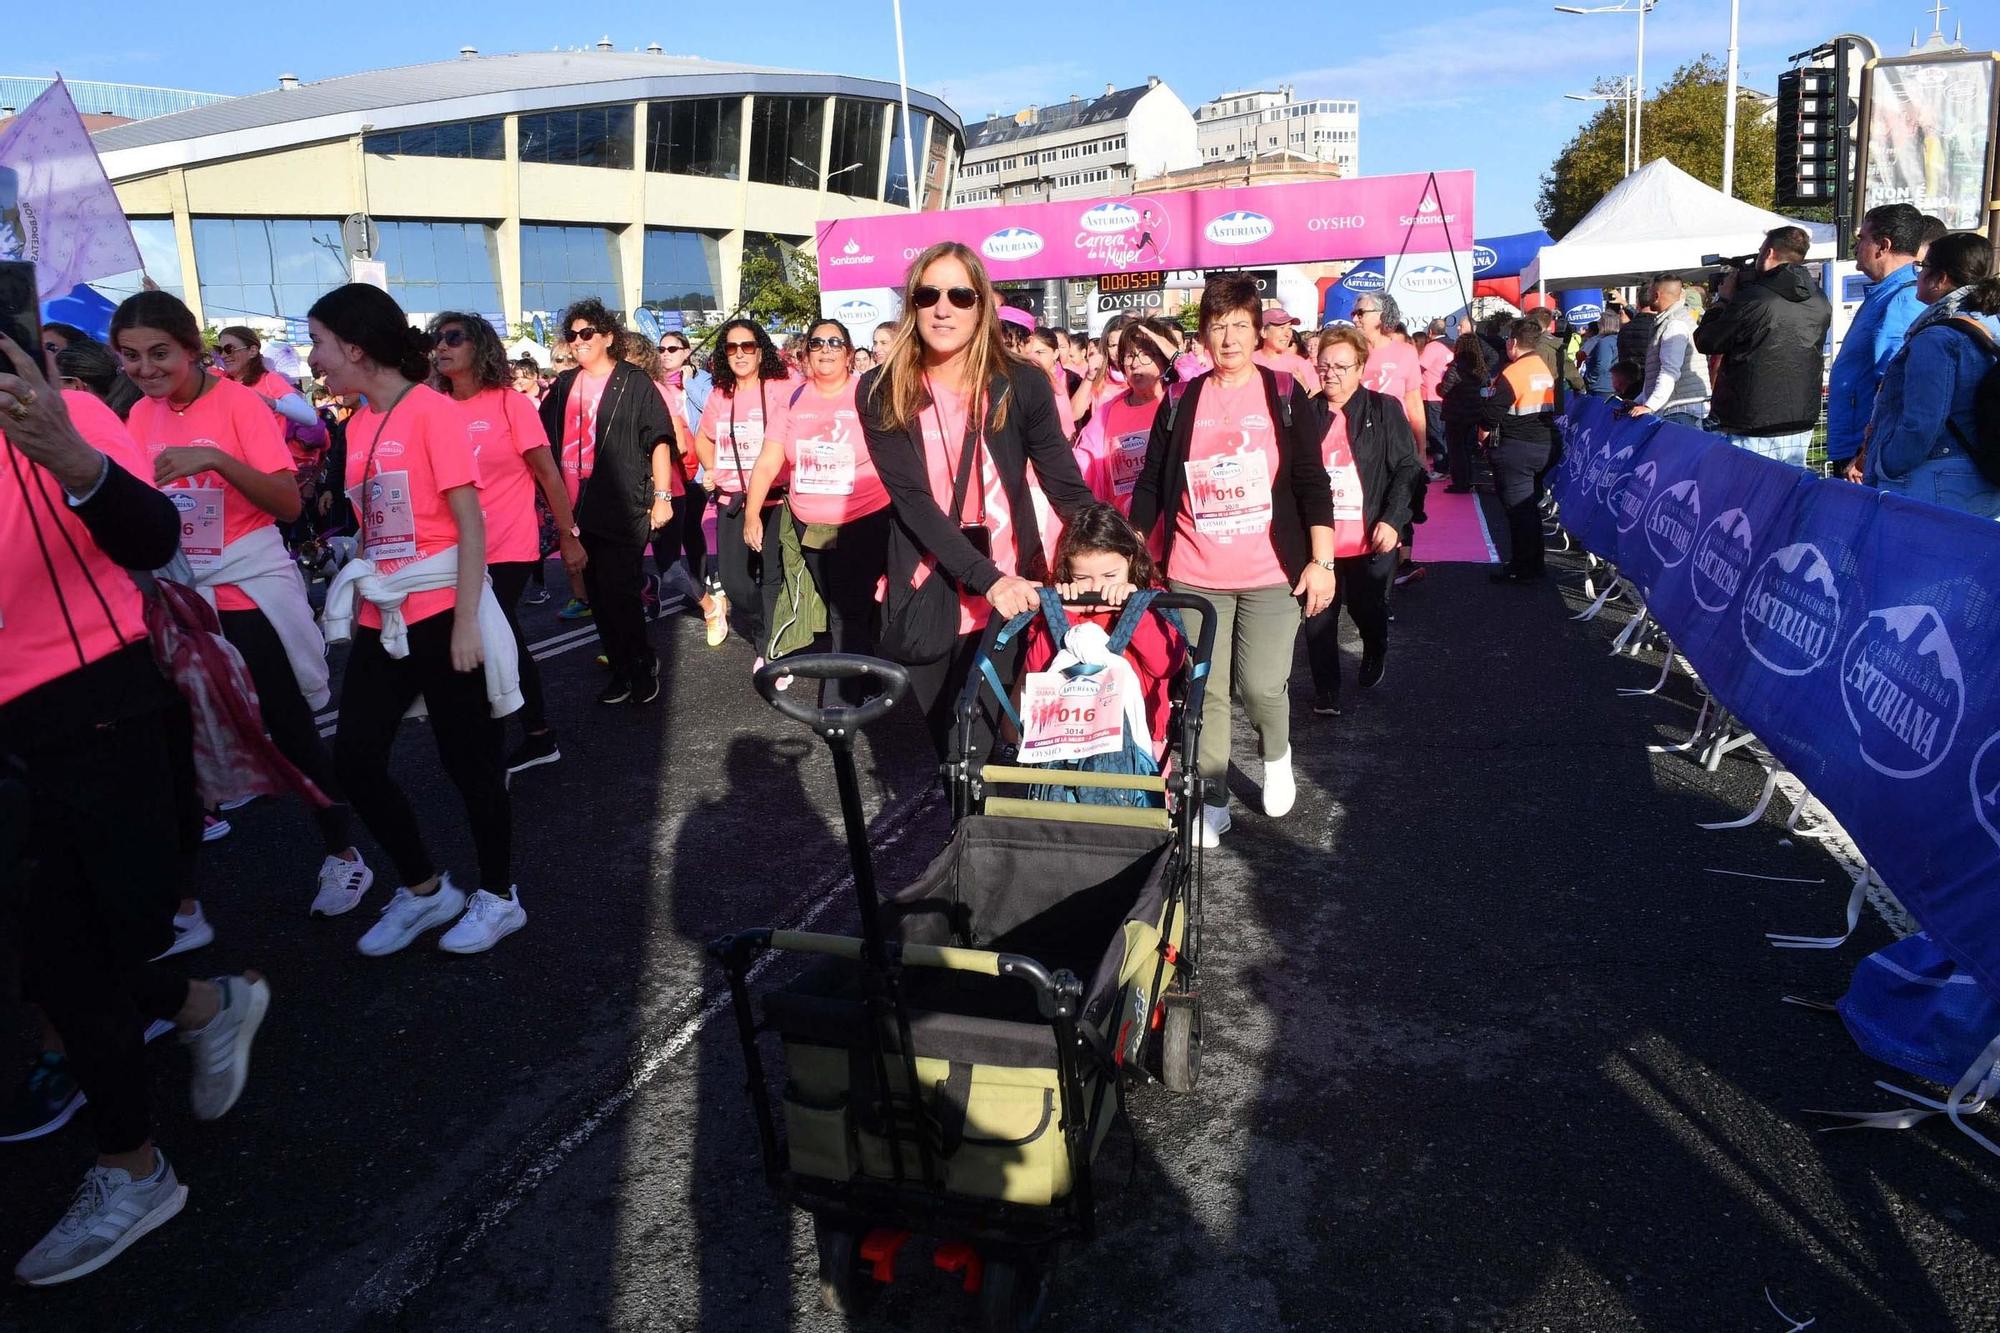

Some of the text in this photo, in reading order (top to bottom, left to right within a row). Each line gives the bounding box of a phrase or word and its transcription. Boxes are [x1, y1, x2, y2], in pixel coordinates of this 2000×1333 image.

[1086, 214, 1136, 227] ASTURIANA
[1308, 215, 1365, 231] OYSHO
[1210, 225, 1269, 239] ASTURIANA
[986, 241, 1040, 254] ASTURIANA
[1075, 233, 1125, 248] Carrera
[829, 254, 875, 266] Santander
[1104, 246, 1142, 270] Mujer
[1101, 272, 1160, 291] 00:05:39
[1405, 276, 1453, 287] ASTURIANA
[1100, 293, 1161, 311] OYSHO
[1216, 486, 1246, 501] 016
[1057, 707, 1096, 723] 016
